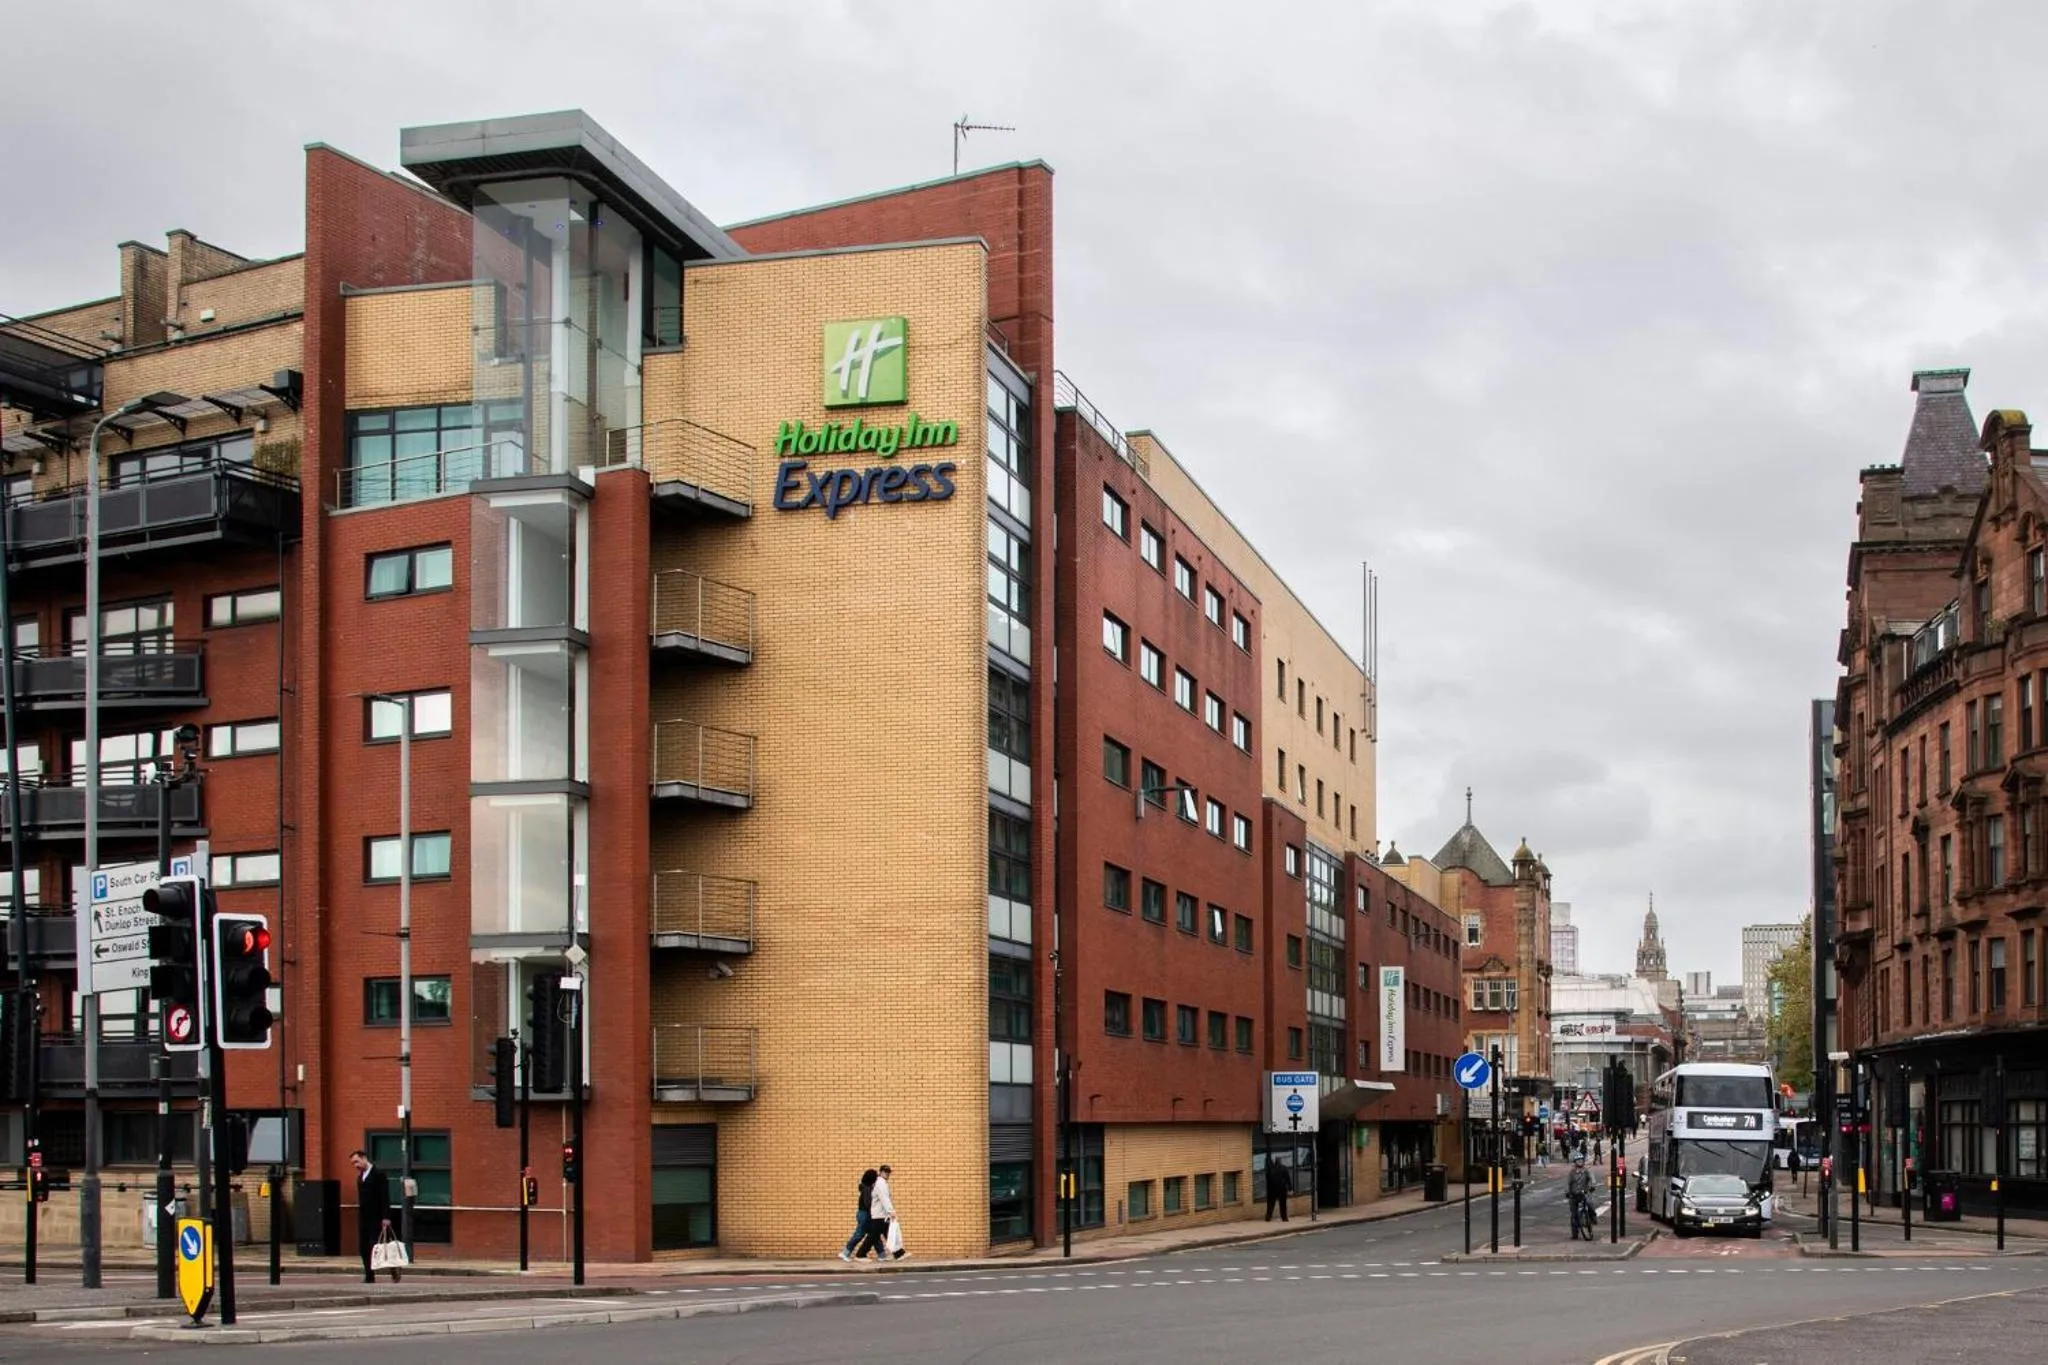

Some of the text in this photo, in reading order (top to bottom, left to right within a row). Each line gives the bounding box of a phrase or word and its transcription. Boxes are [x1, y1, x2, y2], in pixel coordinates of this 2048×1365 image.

[775, 412, 958, 458] Holiday Inn
[773, 459, 956, 520] Express
[96, 871, 161, 898] P South Car Pa
[118, 904, 141, 916] Enoch
[105, 915, 158, 932] Dunlop Street
[111, 940, 150, 953] Oswald S
[132, 967, 149, 979] King
[1276, 1075, 1315, 1084] BUS GATE
